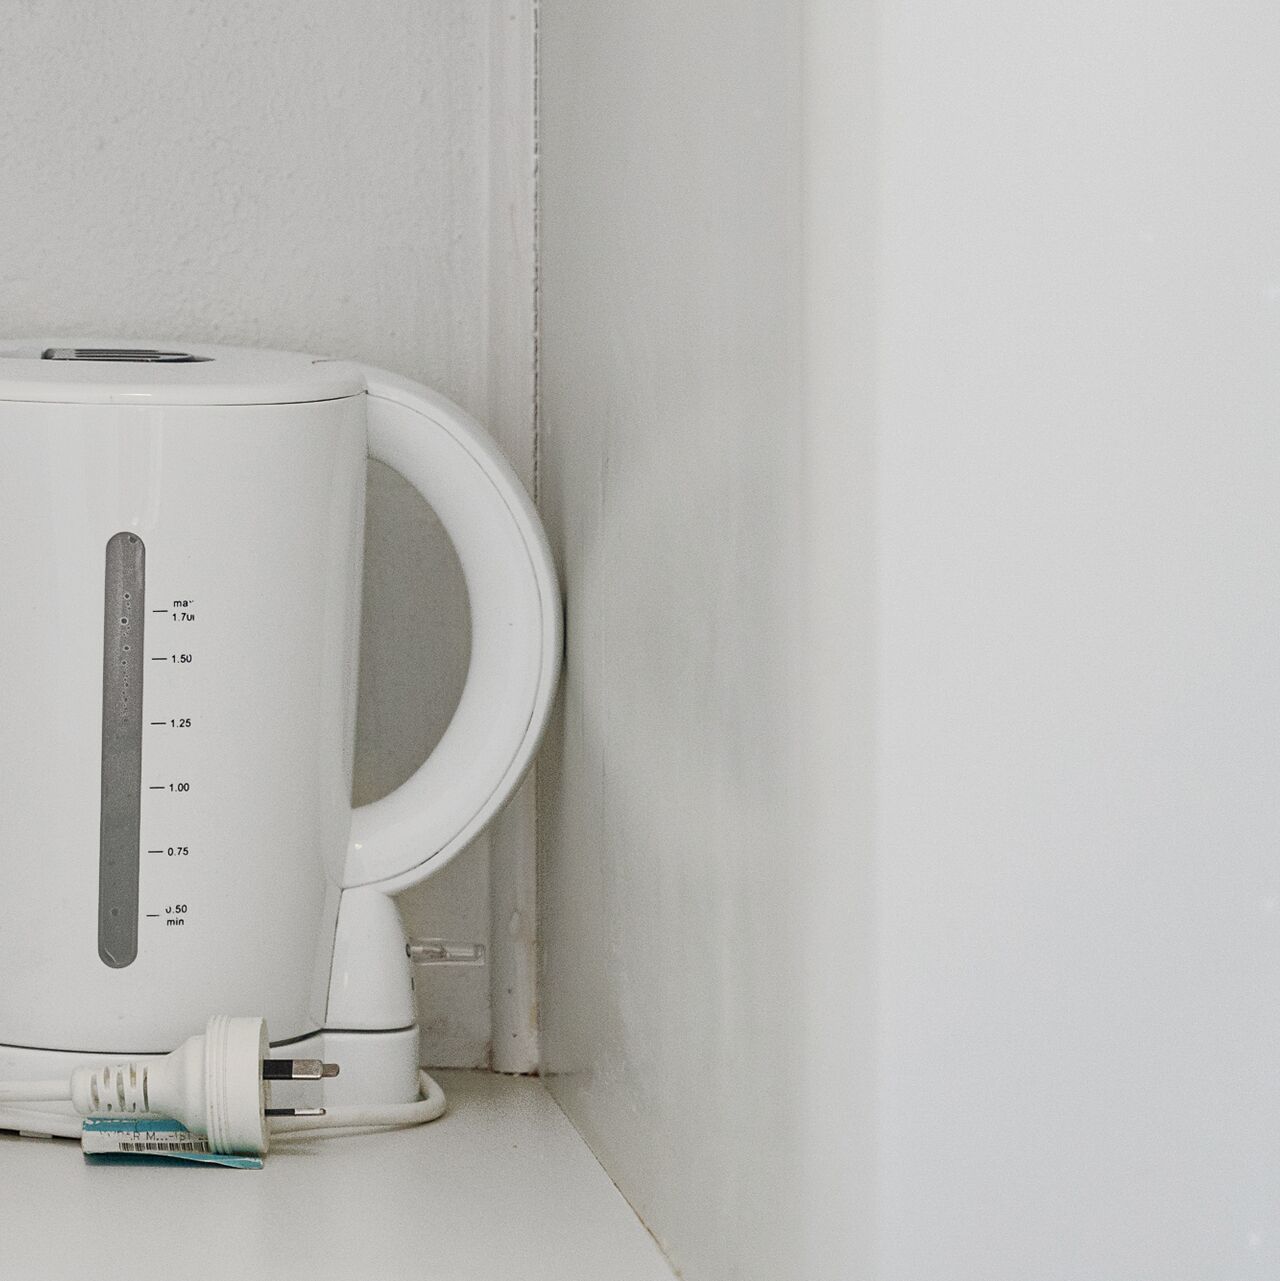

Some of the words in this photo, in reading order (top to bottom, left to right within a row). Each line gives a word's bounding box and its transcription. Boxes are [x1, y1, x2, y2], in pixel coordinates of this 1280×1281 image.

[172, 654, 192, 664] 1.50
[170, 719, 192, 728] 1.25
[169, 783, 190, 792] 1.00
[167, 848, 189, 856] 0.75
[166, 916, 184, 926] min
